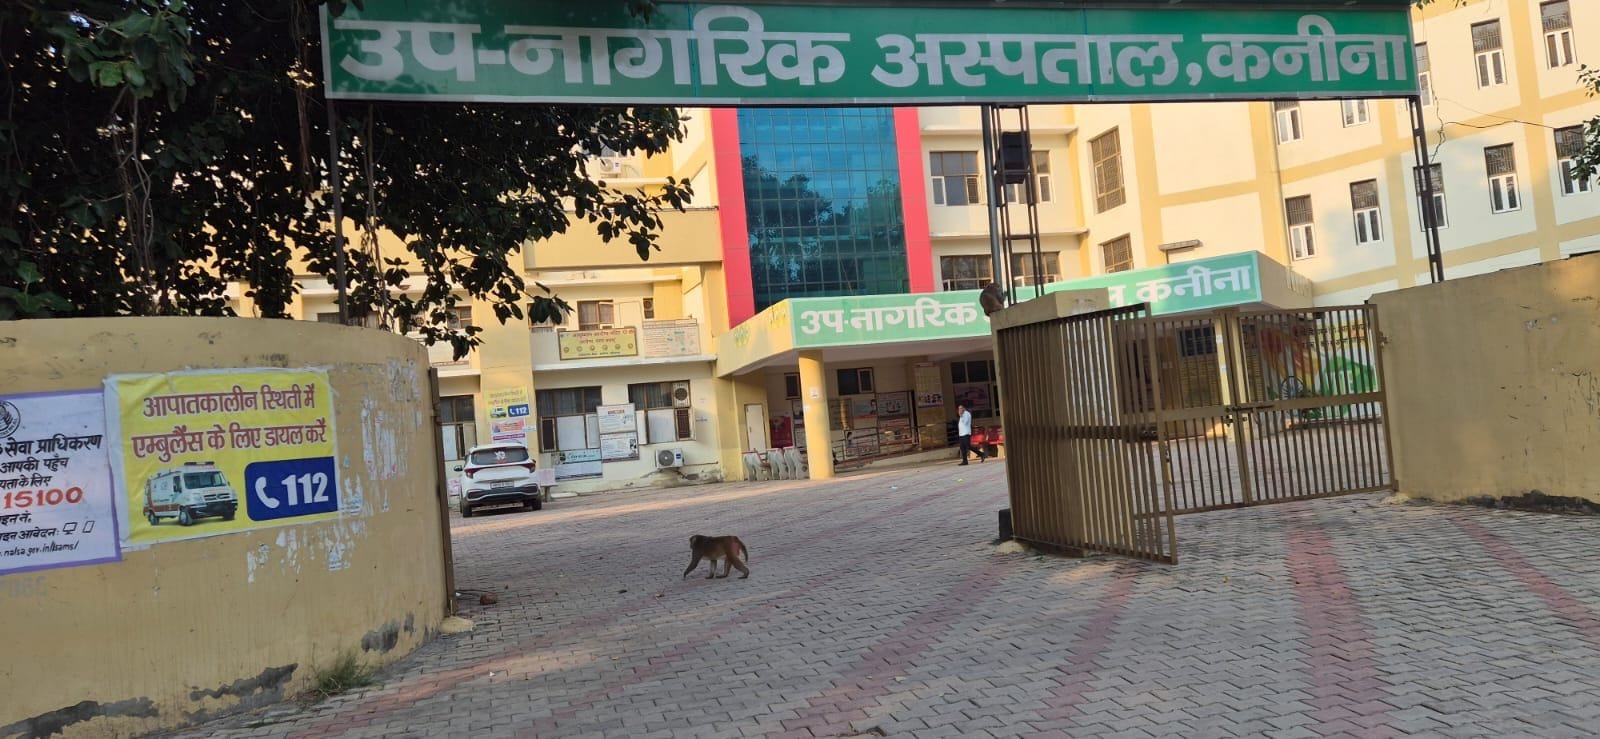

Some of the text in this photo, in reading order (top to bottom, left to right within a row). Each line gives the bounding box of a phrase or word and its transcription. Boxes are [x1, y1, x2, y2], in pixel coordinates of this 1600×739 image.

[335, 5, 850, 87] उप-नागरिक
[143, 385, 258, 417] आपातकालीन
[516, 406, 528, 415] 112
[5, 437, 35, 457] सेवा
[36, 433, 103, 454] प्राधिकरण
[206, 424, 226, 450] के
[229, 422, 261, 449] लिए
[263, 426, 303, 446] डायल
[0, 457, 40, 473] आपकी
[4, 486, 83, 509] 15100
[281, 472, 329, 506] 112
